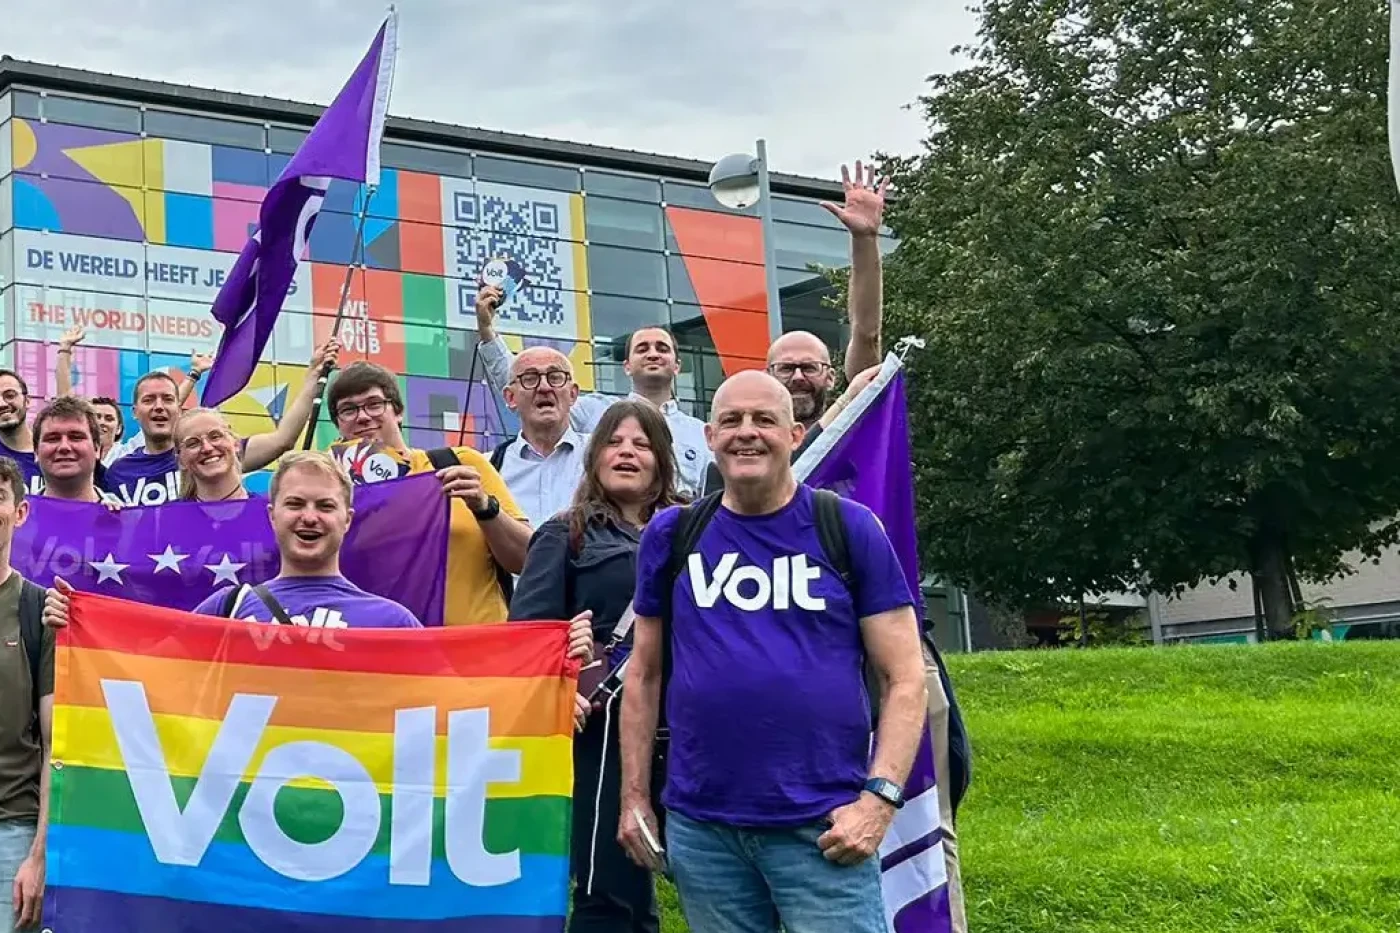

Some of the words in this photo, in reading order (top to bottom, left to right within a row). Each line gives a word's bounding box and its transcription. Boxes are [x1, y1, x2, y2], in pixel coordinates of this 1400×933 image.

[27, 249, 54, 269] DE
[59, 252, 138, 279] WERELD
[145, 262, 199, 285] HEEFT
[203, 267, 224, 288] JE
[28, 303, 65, 325] THE
[71, 307, 146, 332] WORLD
[152, 316, 213, 338] NEEDS
[342, 301, 368, 320] WE
[342, 319, 377, 337] ARE
[342, 333, 381, 354] VUB
[369, 459, 393, 480] Volt
[687, 552, 826, 611] Volt
[100, 679, 522, 887] Volt
